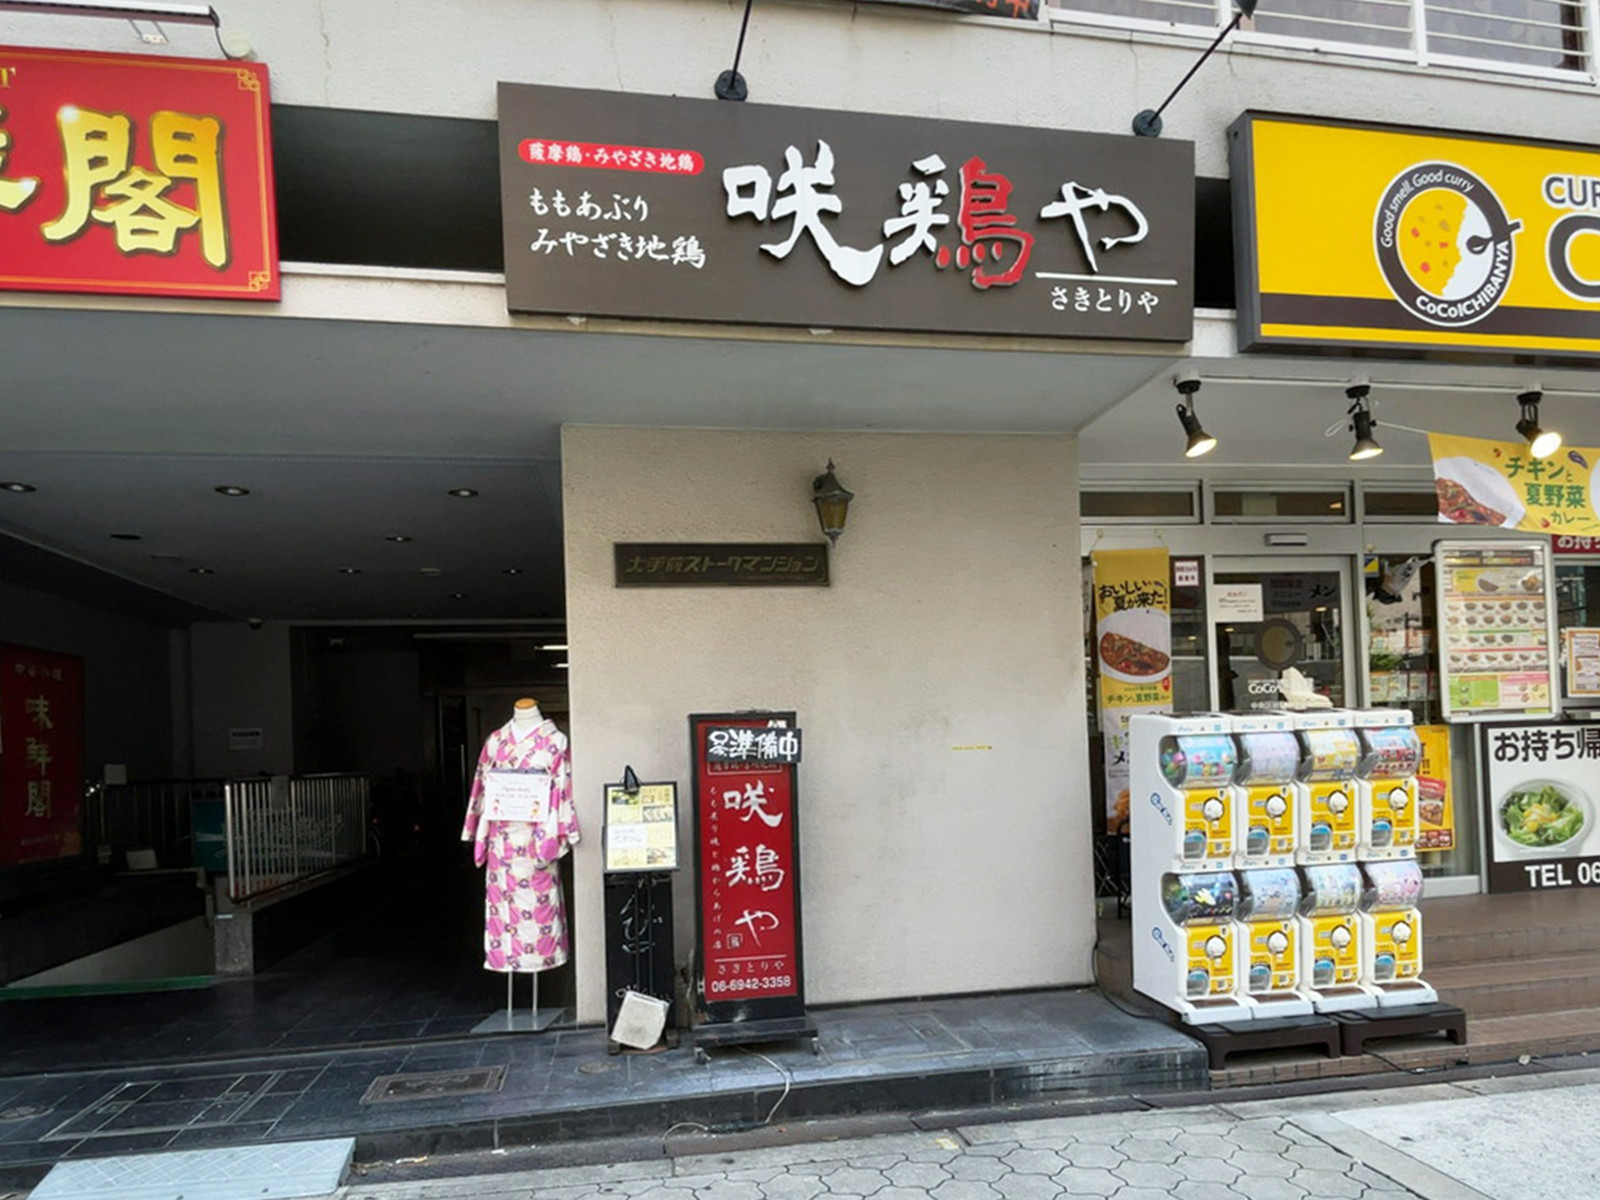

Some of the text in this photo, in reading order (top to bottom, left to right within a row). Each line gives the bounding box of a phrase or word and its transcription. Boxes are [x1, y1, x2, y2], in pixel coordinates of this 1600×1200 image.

[528, 142, 695, 172] 薩摩鶏・みやざき地鶏
[0, 104, 228, 270] 閣
[529, 188, 650, 222] ももあぶり
[1380, 210, 1397, 248] Good
[1412, 169, 1443, 188] Good
[1444, 173, 1475, 193] curry
[530, 228, 707, 269] みやざき地鶏
[1414, 239, 1511, 318] CoCoICHIBANYA
[1051, 286, 1159, 315] さきとりや
[1504, 456, 1574, 483] チキンと
[1524, 482, 1586, 508] 夏野菜
[1550, 511, 1591, 525] カレー
[1494, 728, 1600, 762] お持ち帰
[1525, 864, 1572, 888] TEL
[718, 960, 785, 976] さきとりや
[711, 975, 791, 993] 06-6942-3358
